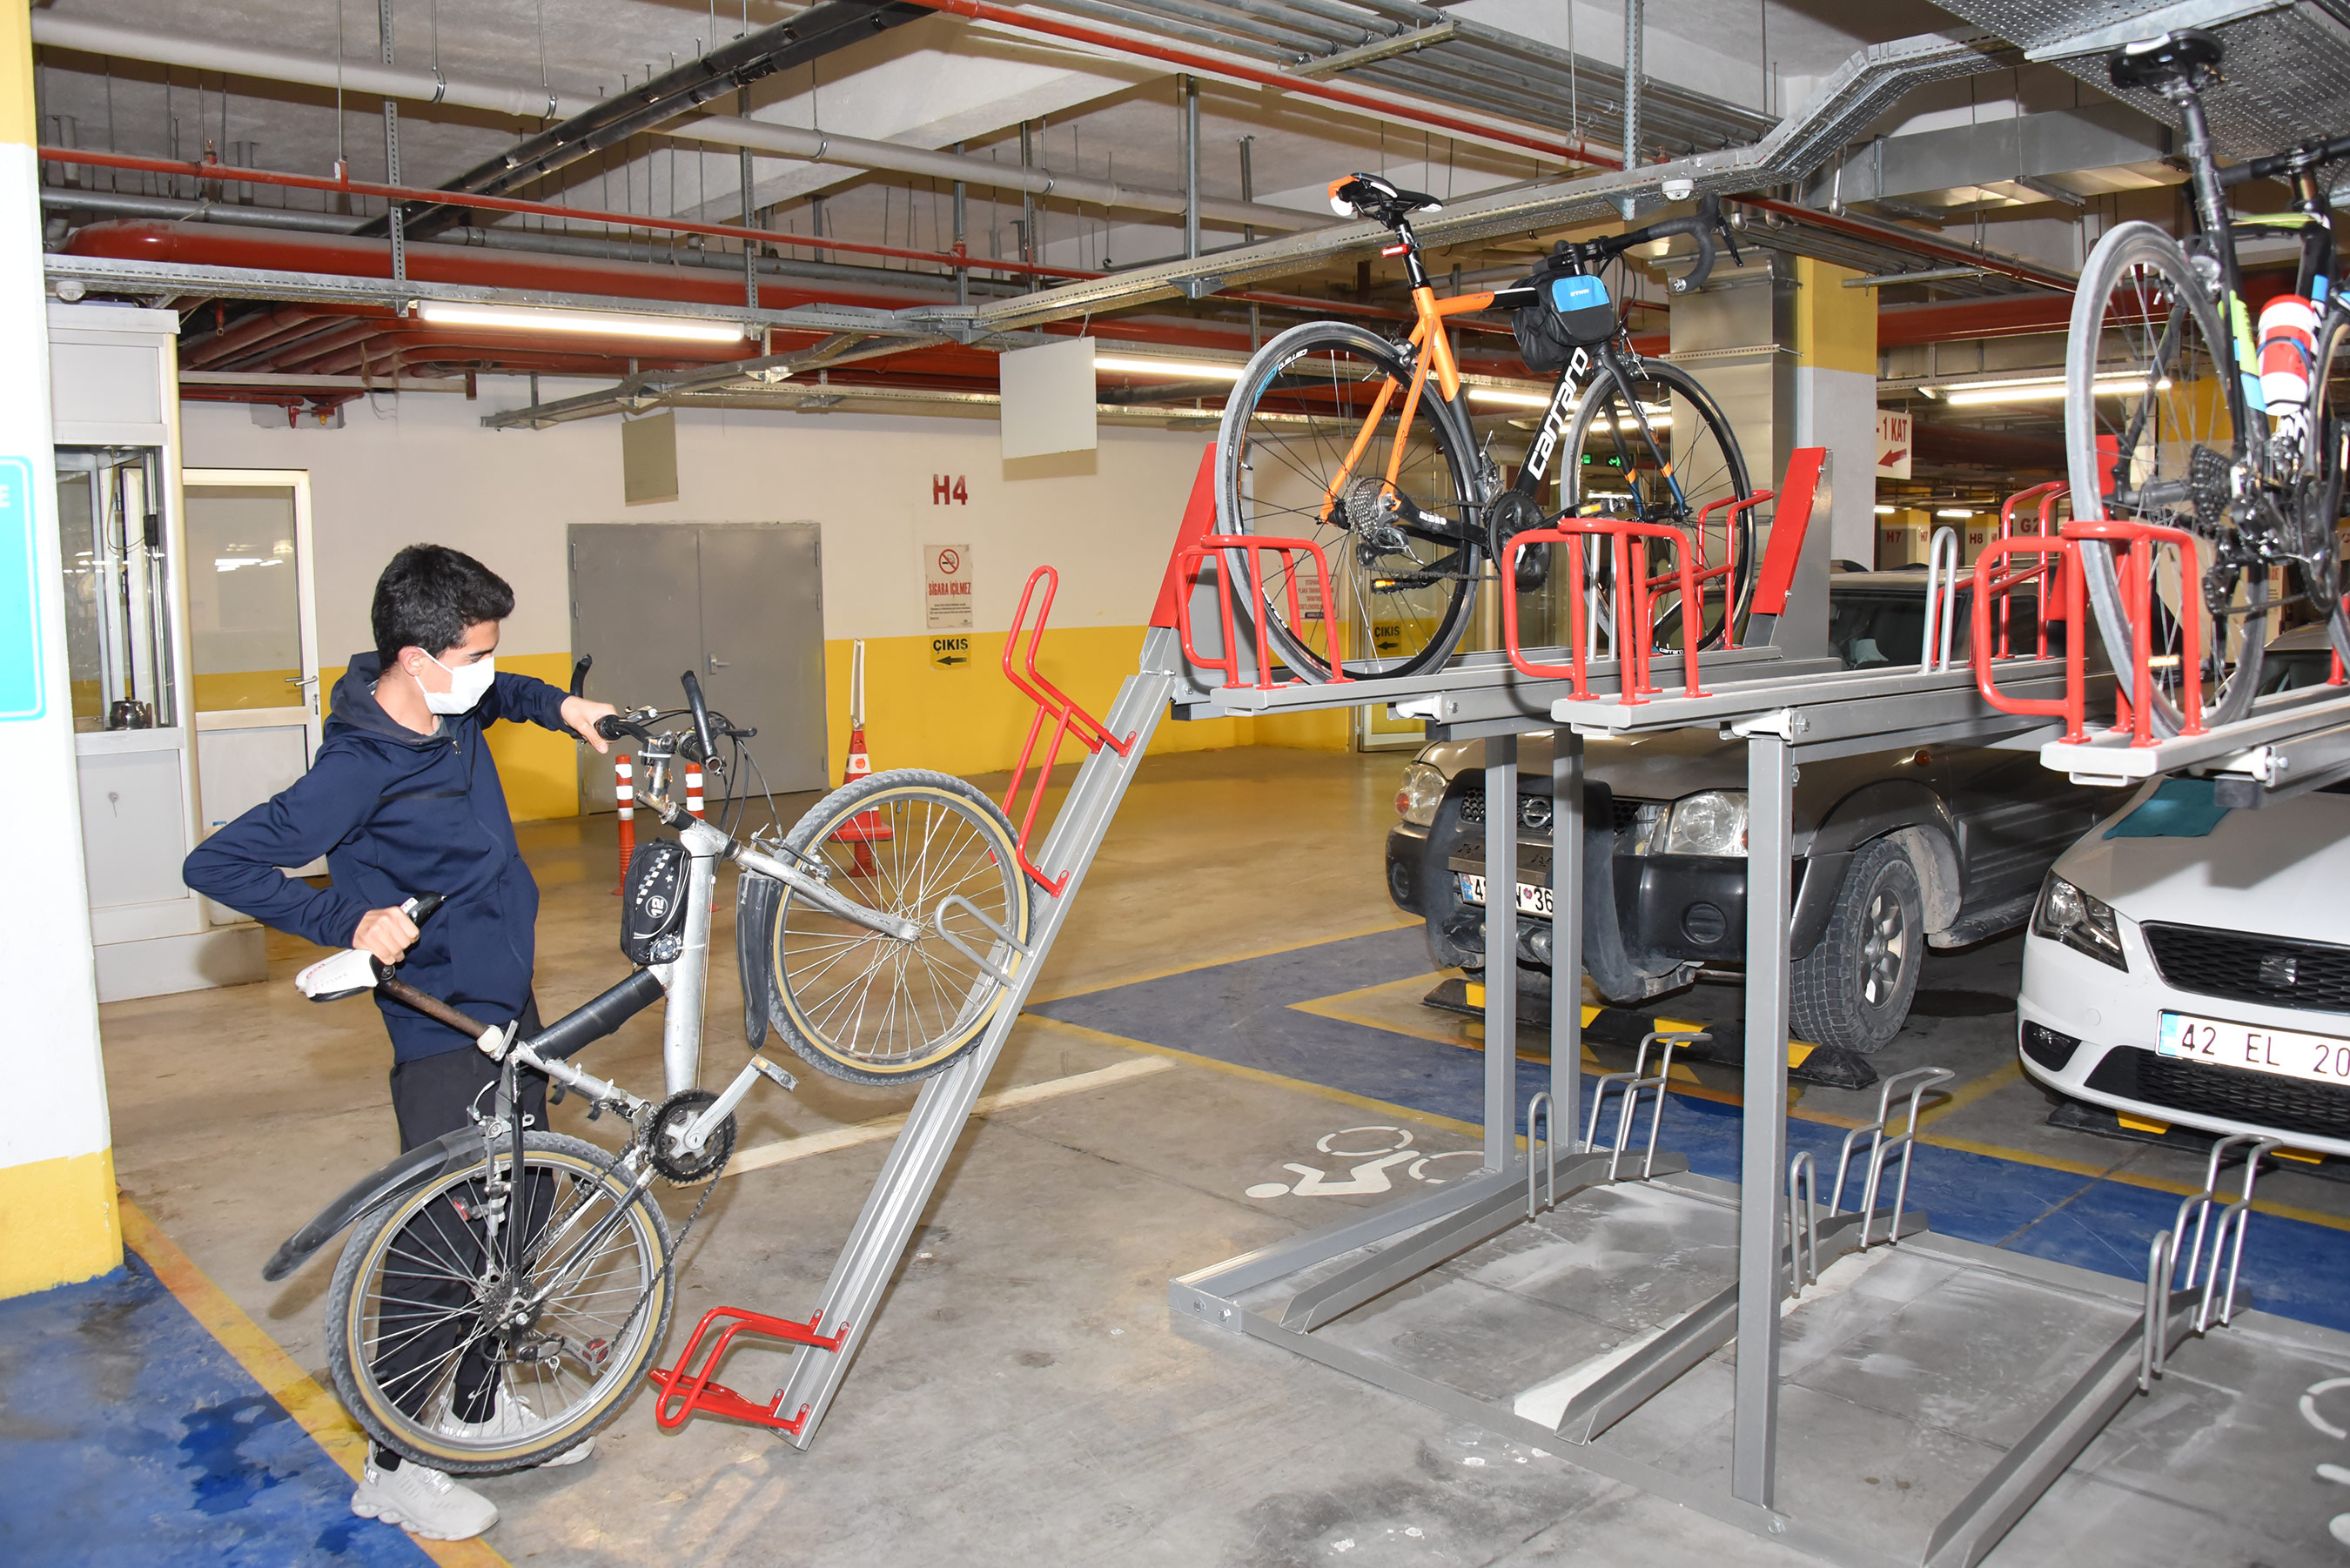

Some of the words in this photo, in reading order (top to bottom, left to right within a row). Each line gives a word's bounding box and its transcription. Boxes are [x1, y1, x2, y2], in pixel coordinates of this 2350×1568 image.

[1528, 346, 1588, 481] carraro
[1891, 417, 1908, 443] KAT
[933, 473, 969, 506] H4
[1886, 531, 1902, 543] H7
[1969, 533, 1984, 544] H8
[929, 580, 950, 596] SİGARA
[933, 638, 969, 654] ÇIKIŞ
[2182, 1023, 2216, 1055] 42
[2246, 1033, 2280, 1067] EL
